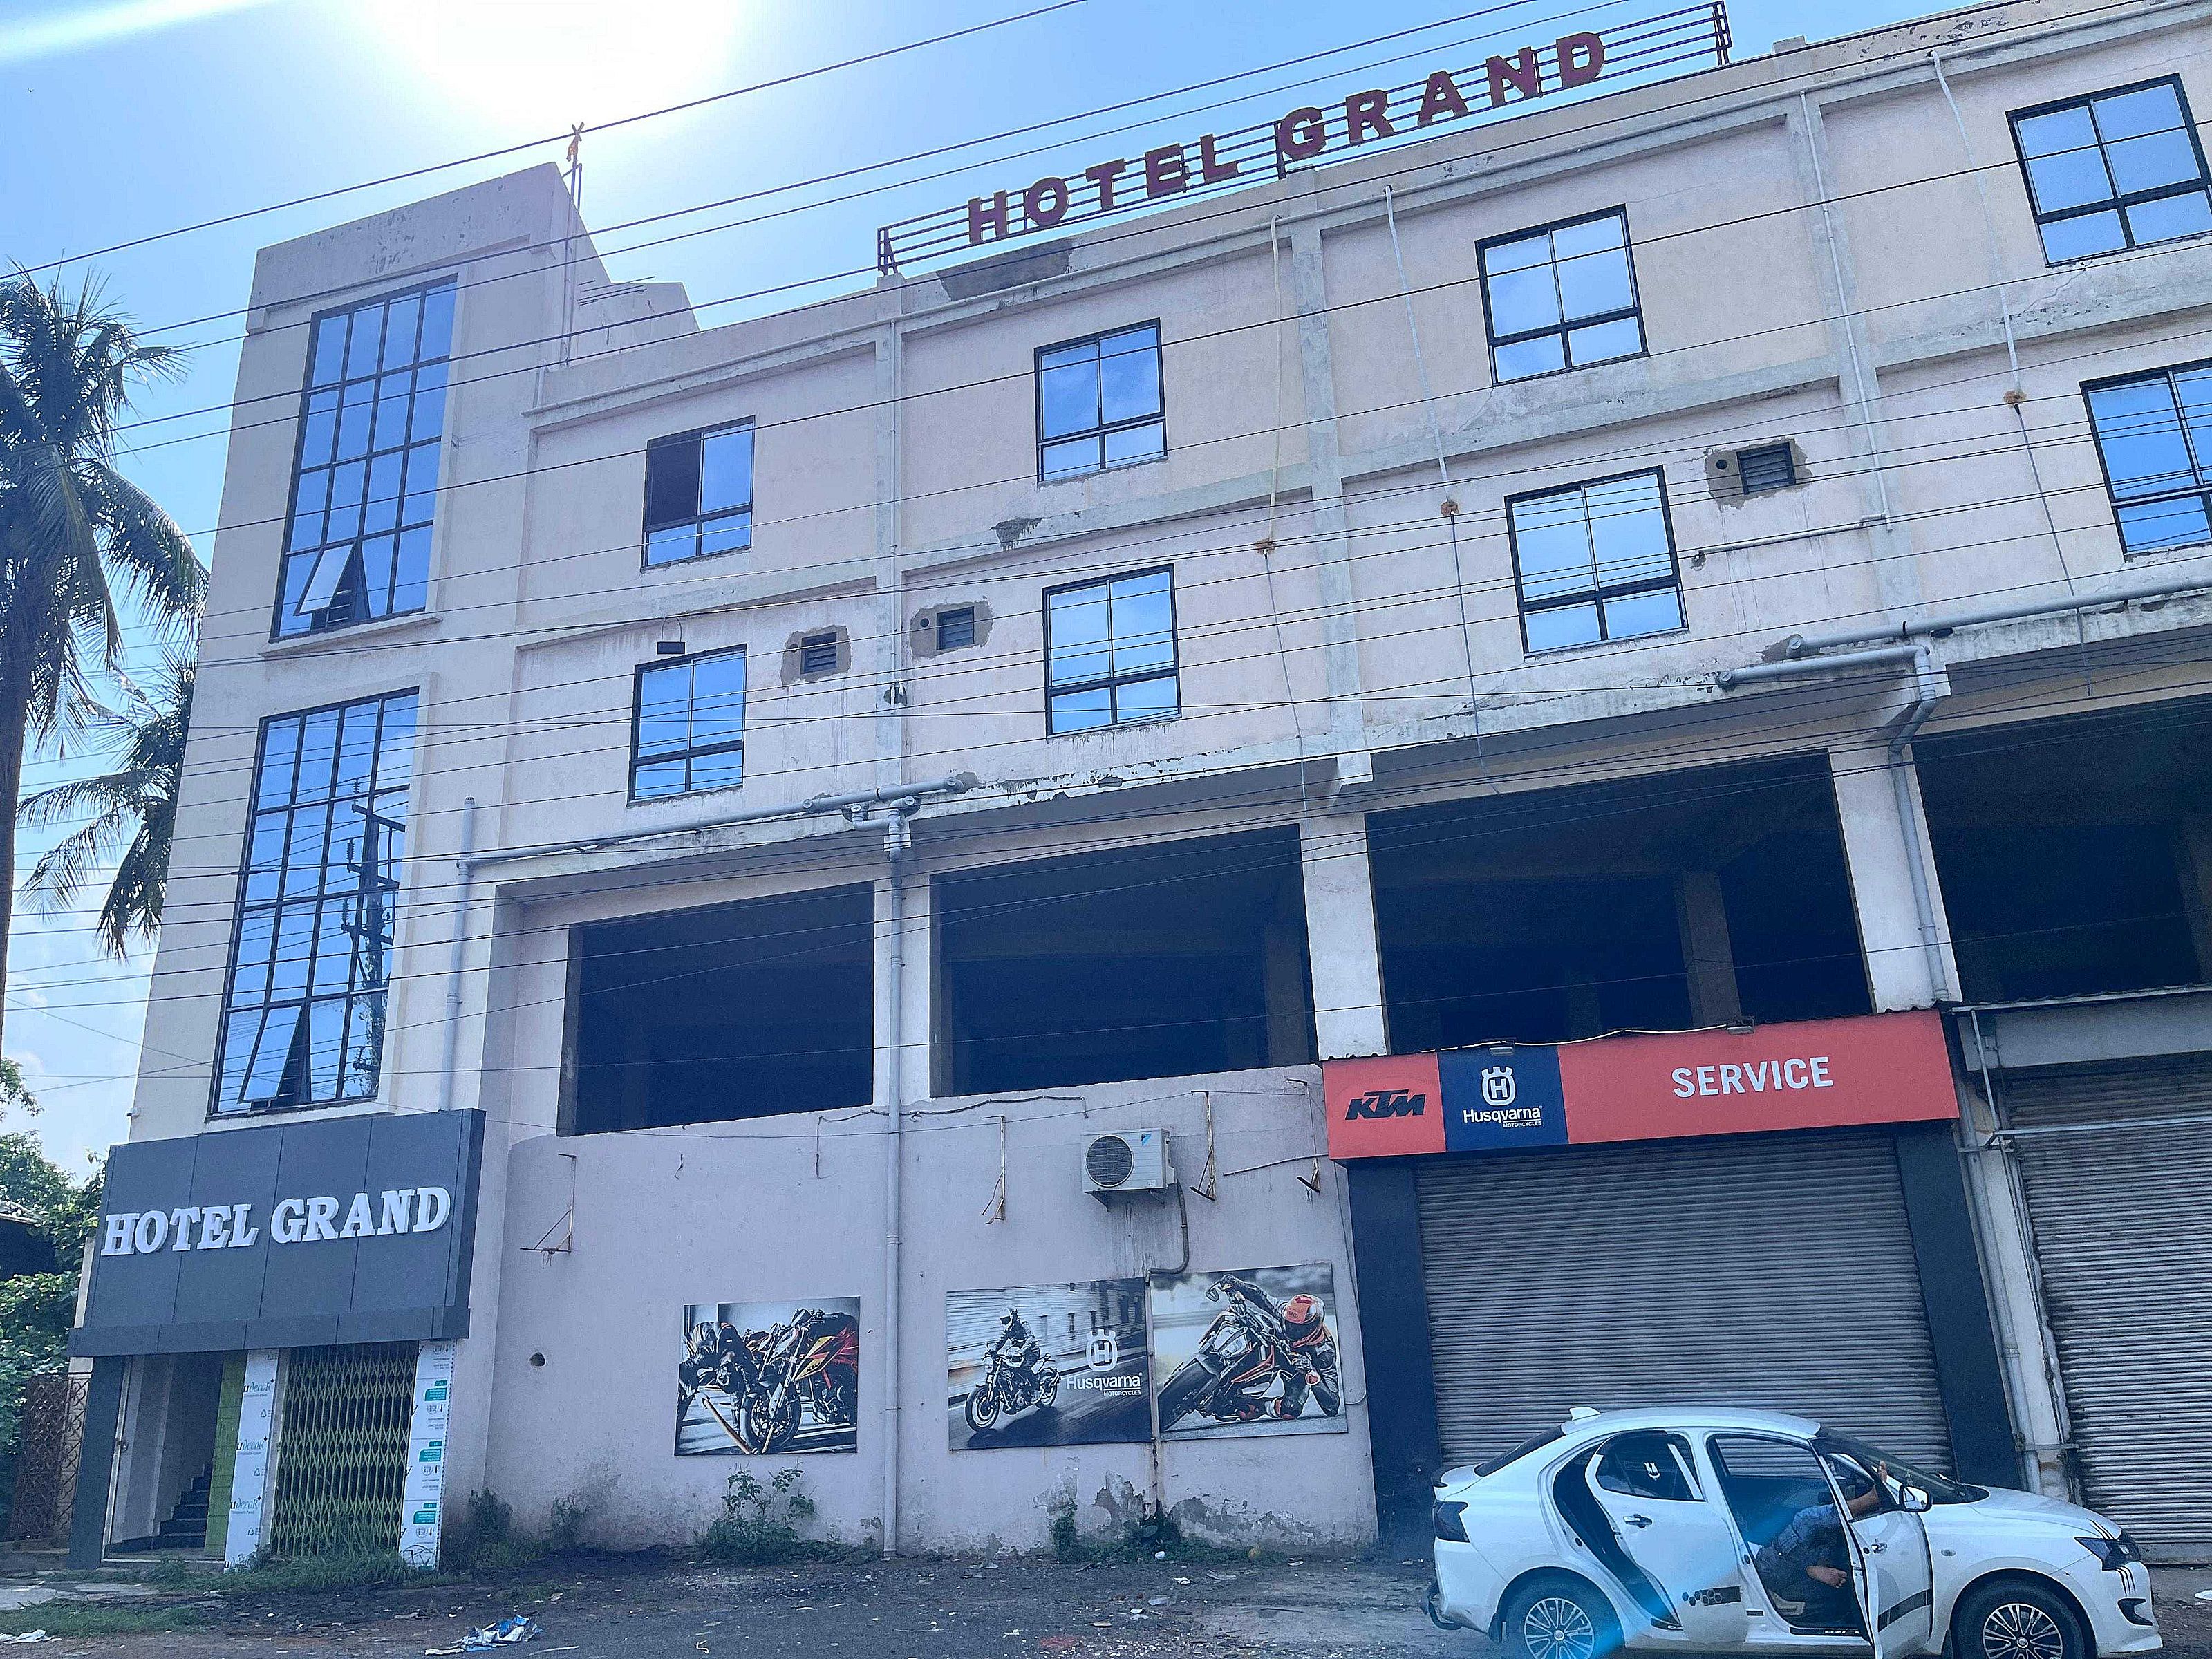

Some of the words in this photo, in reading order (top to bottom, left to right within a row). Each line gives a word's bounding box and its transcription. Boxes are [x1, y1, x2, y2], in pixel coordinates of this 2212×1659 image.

[968, 133, 1239, 245] HOTEL
[1277, 32, 1604, 160] GRAND
[1671, 1056, 1834, 1098] SERVICE
[1345, 1089, 1425, 1120] KTM
[1463, 1107, 1541, 1123] Husqvarna
[100, 1203, 259, 1256] HOTEL
[270, 1186, 451, 1244] GRAND
[1067, 1375, 1141, 1391] Husqvarna
